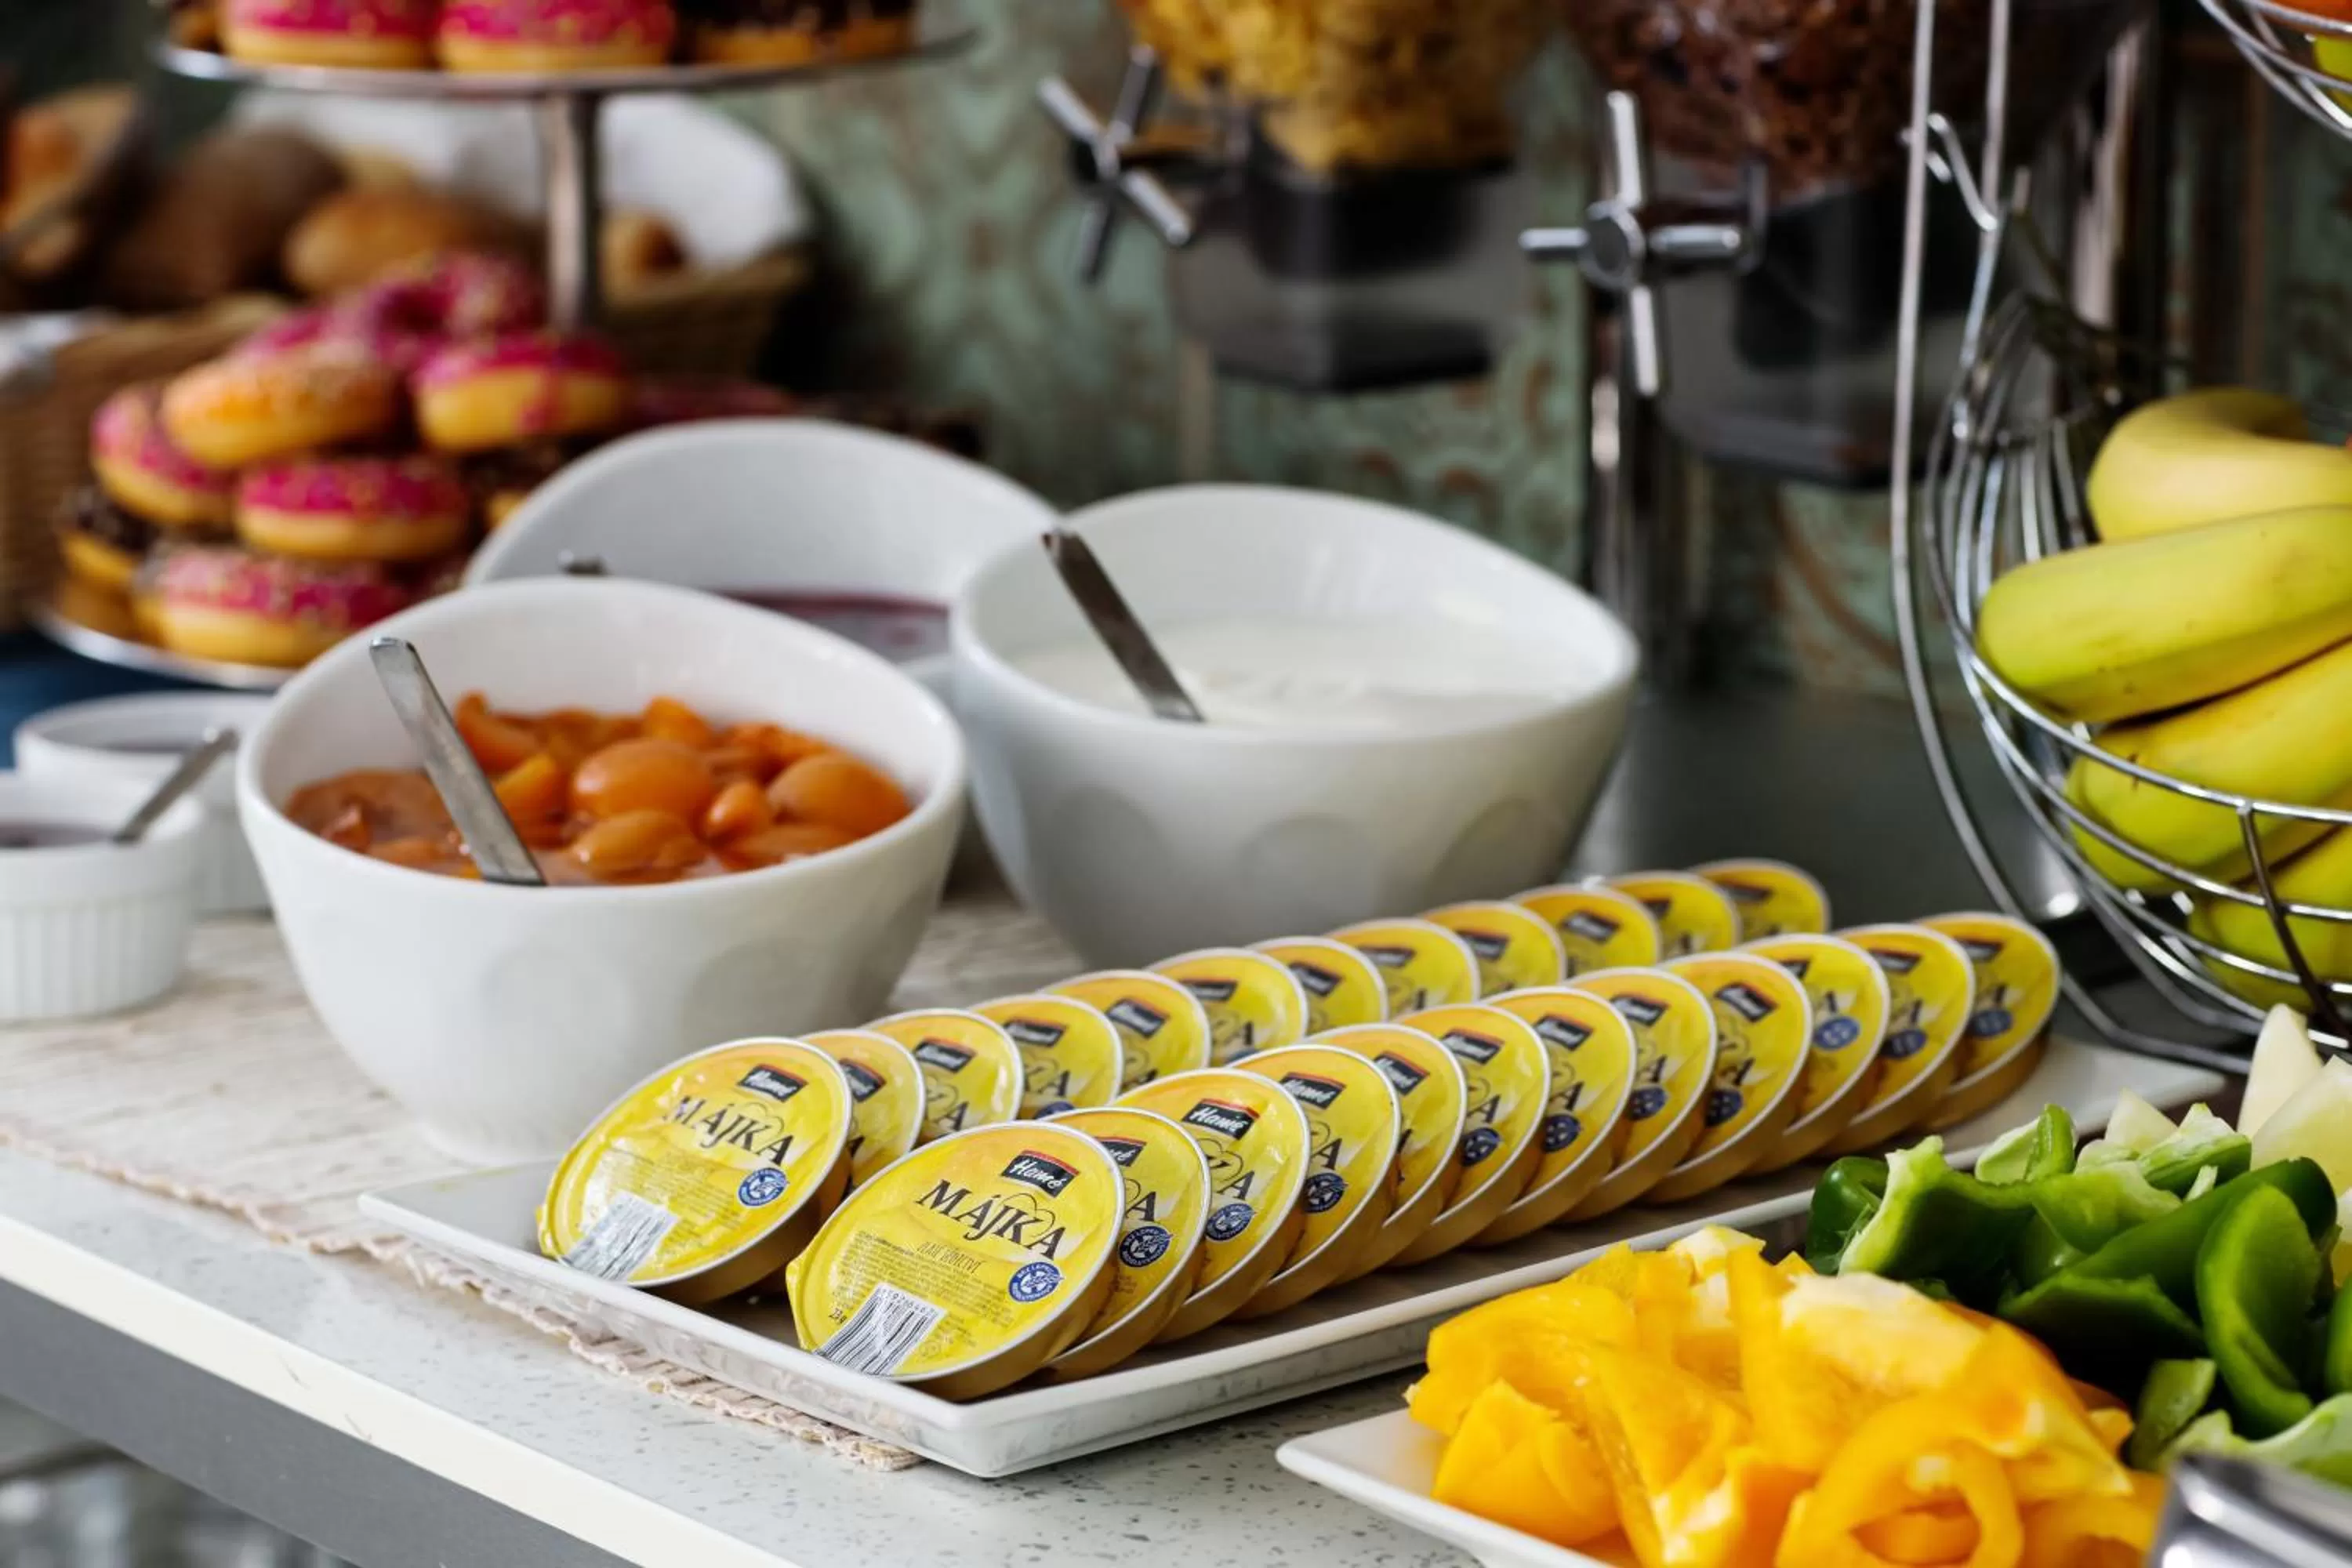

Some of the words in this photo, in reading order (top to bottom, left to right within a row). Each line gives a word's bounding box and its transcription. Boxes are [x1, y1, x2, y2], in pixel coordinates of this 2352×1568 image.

[662, 1095, 794, 1167] MÁJKA
[1008, 1158, 1068, 1190] Hamé
[915, 1178, 1066, 1261] MÁJKA
